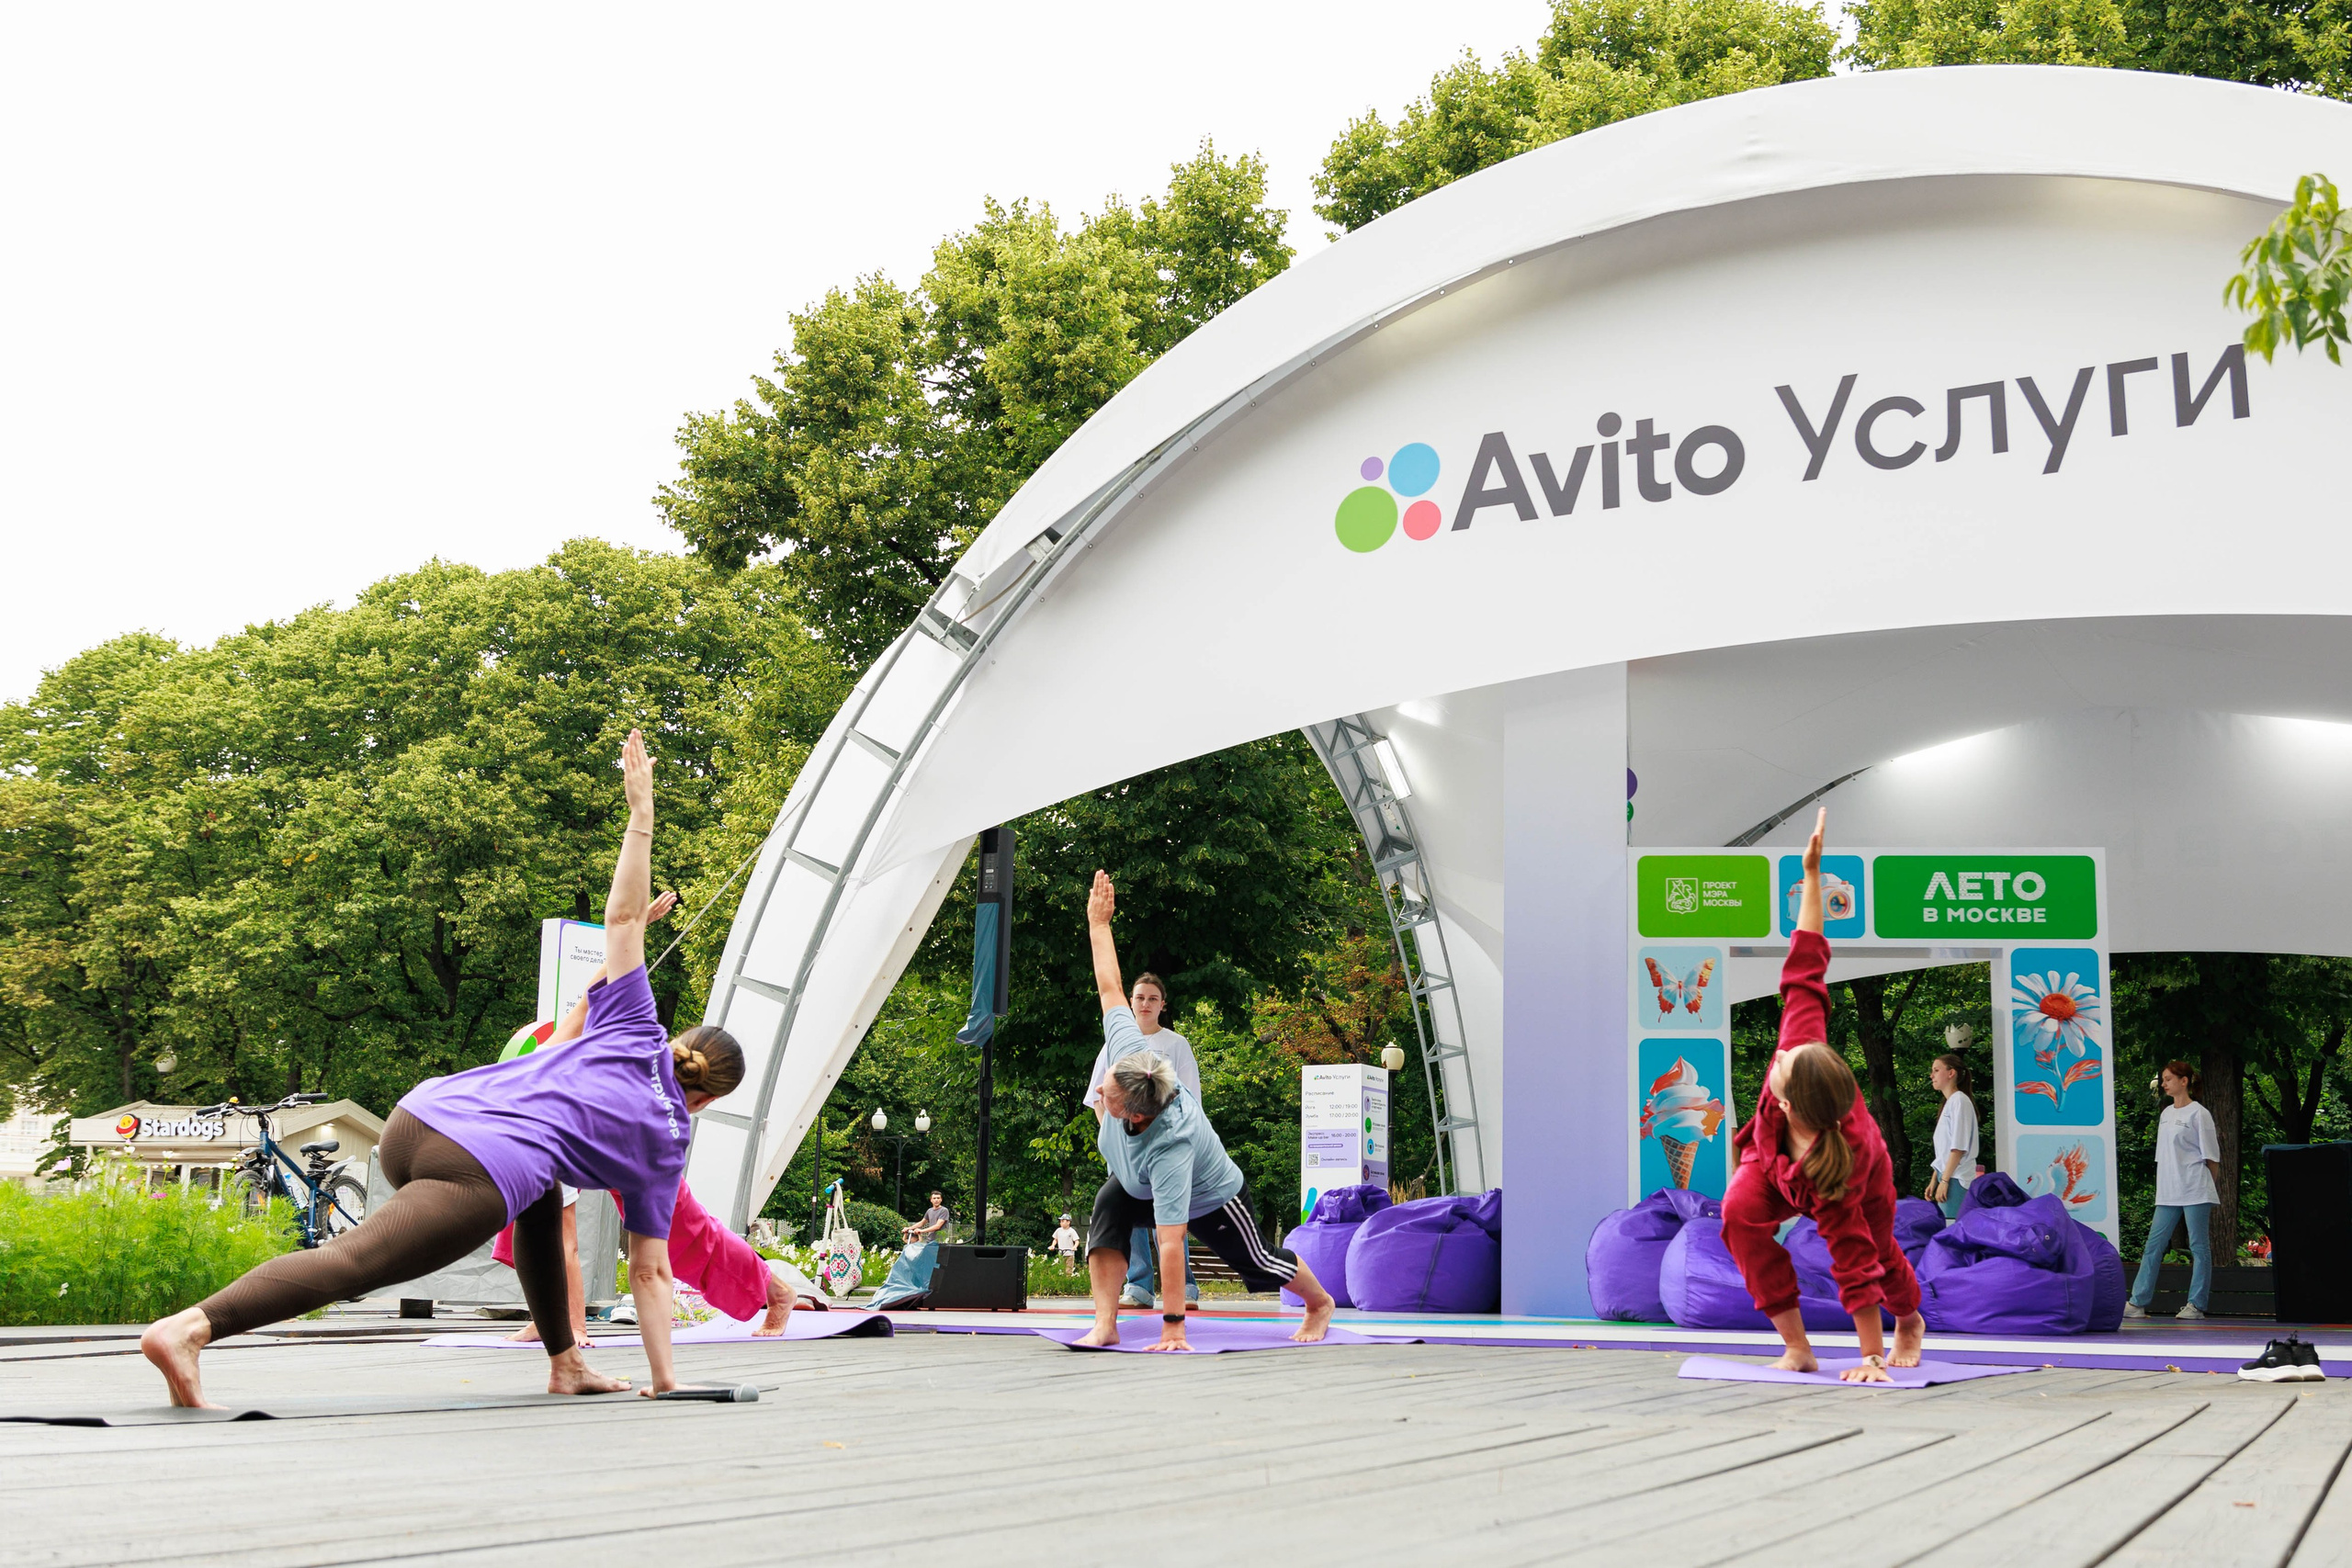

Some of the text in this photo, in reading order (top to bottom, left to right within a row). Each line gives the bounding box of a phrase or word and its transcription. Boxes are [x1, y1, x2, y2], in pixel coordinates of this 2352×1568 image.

[1451, 344, 2250, 532] Avito Услуги
[1702, 881, 1737, 889] ПРОЕКТ
[1923, 871, 2046, 901] ЛЕТО
[1702, 890, 1728, 898] МЭРА
[1923, 907, 2047, 923] В МОСКВЕ
[570, 954, 590, 963] своего
[140, 1118, 225, 1141] Stardogs
